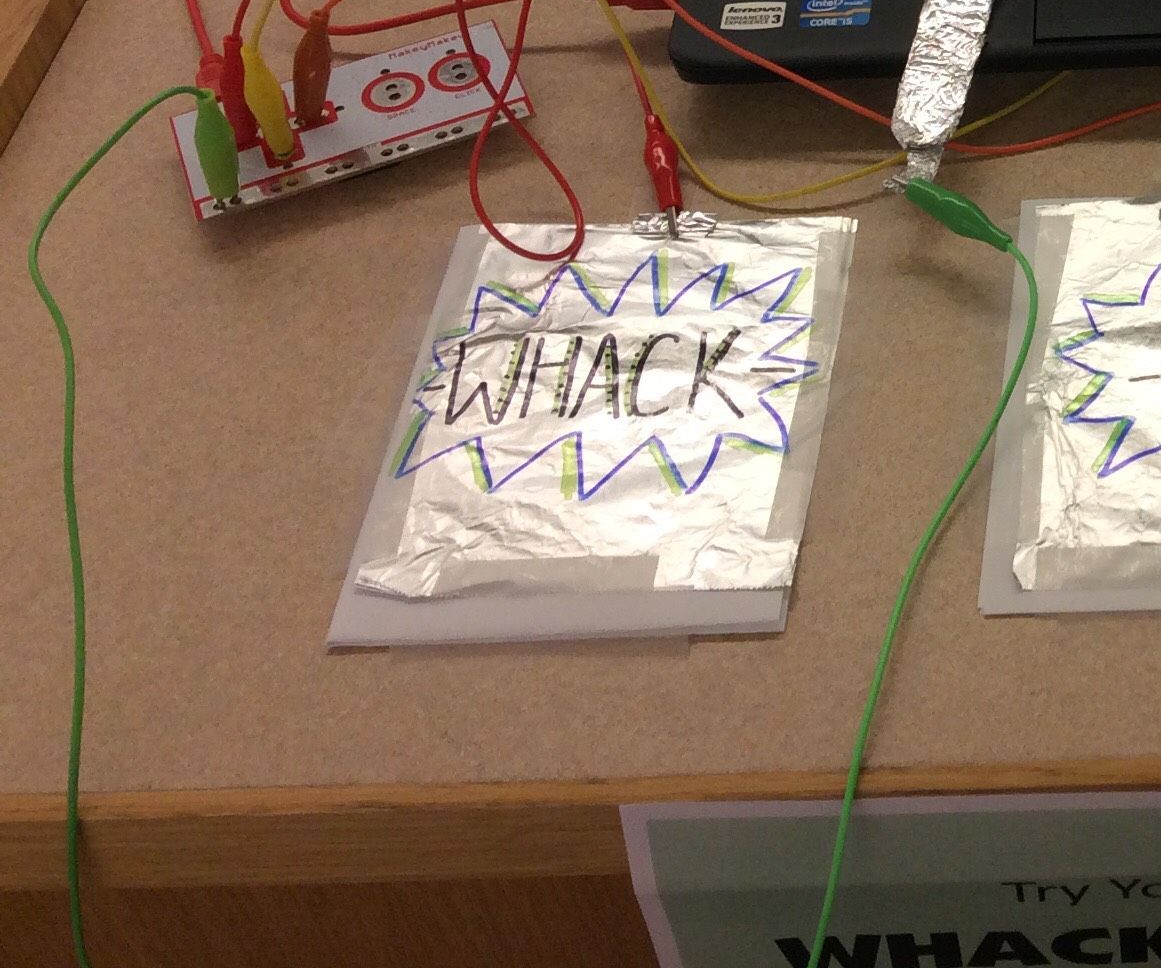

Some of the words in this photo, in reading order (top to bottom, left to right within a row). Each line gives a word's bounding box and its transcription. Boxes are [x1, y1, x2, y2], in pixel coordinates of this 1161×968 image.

[771, 14, 781, 24] 3
[809, 18, 838, 27] CORE
[1001, 881, 1091, 906] Try
